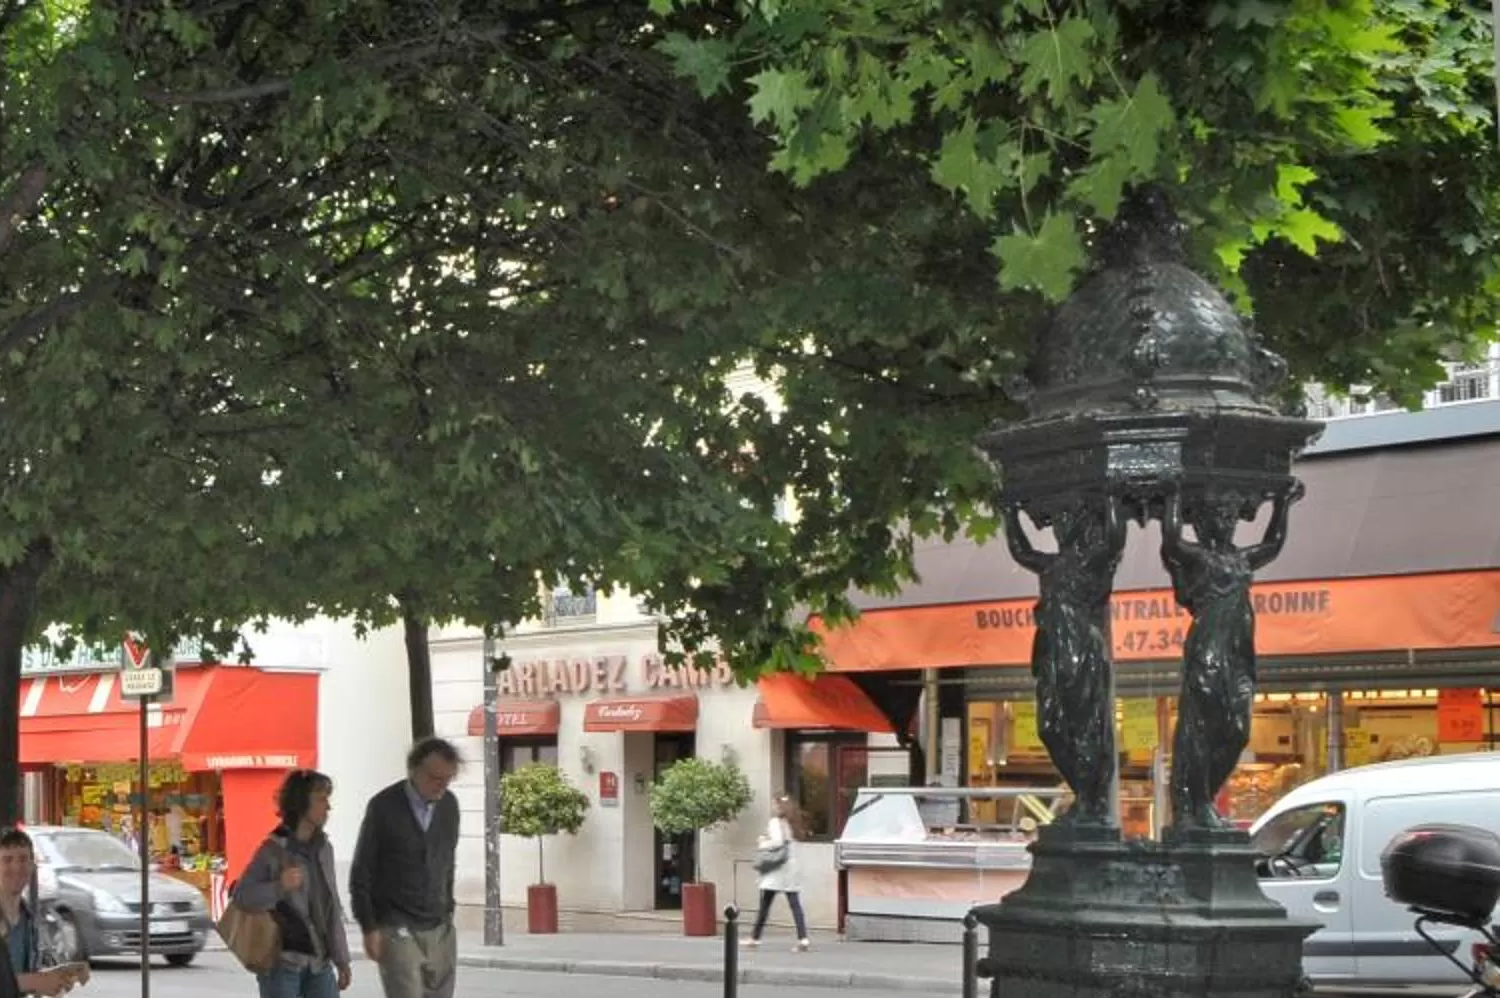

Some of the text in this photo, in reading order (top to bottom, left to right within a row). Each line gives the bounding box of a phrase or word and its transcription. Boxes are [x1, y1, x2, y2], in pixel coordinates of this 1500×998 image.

[975, 589, 1332, 630] BOUCH NTRALE RONNE
[497, 653, 628, 698] ARLADEZ
[496, 712, 530, 727] OTEL
